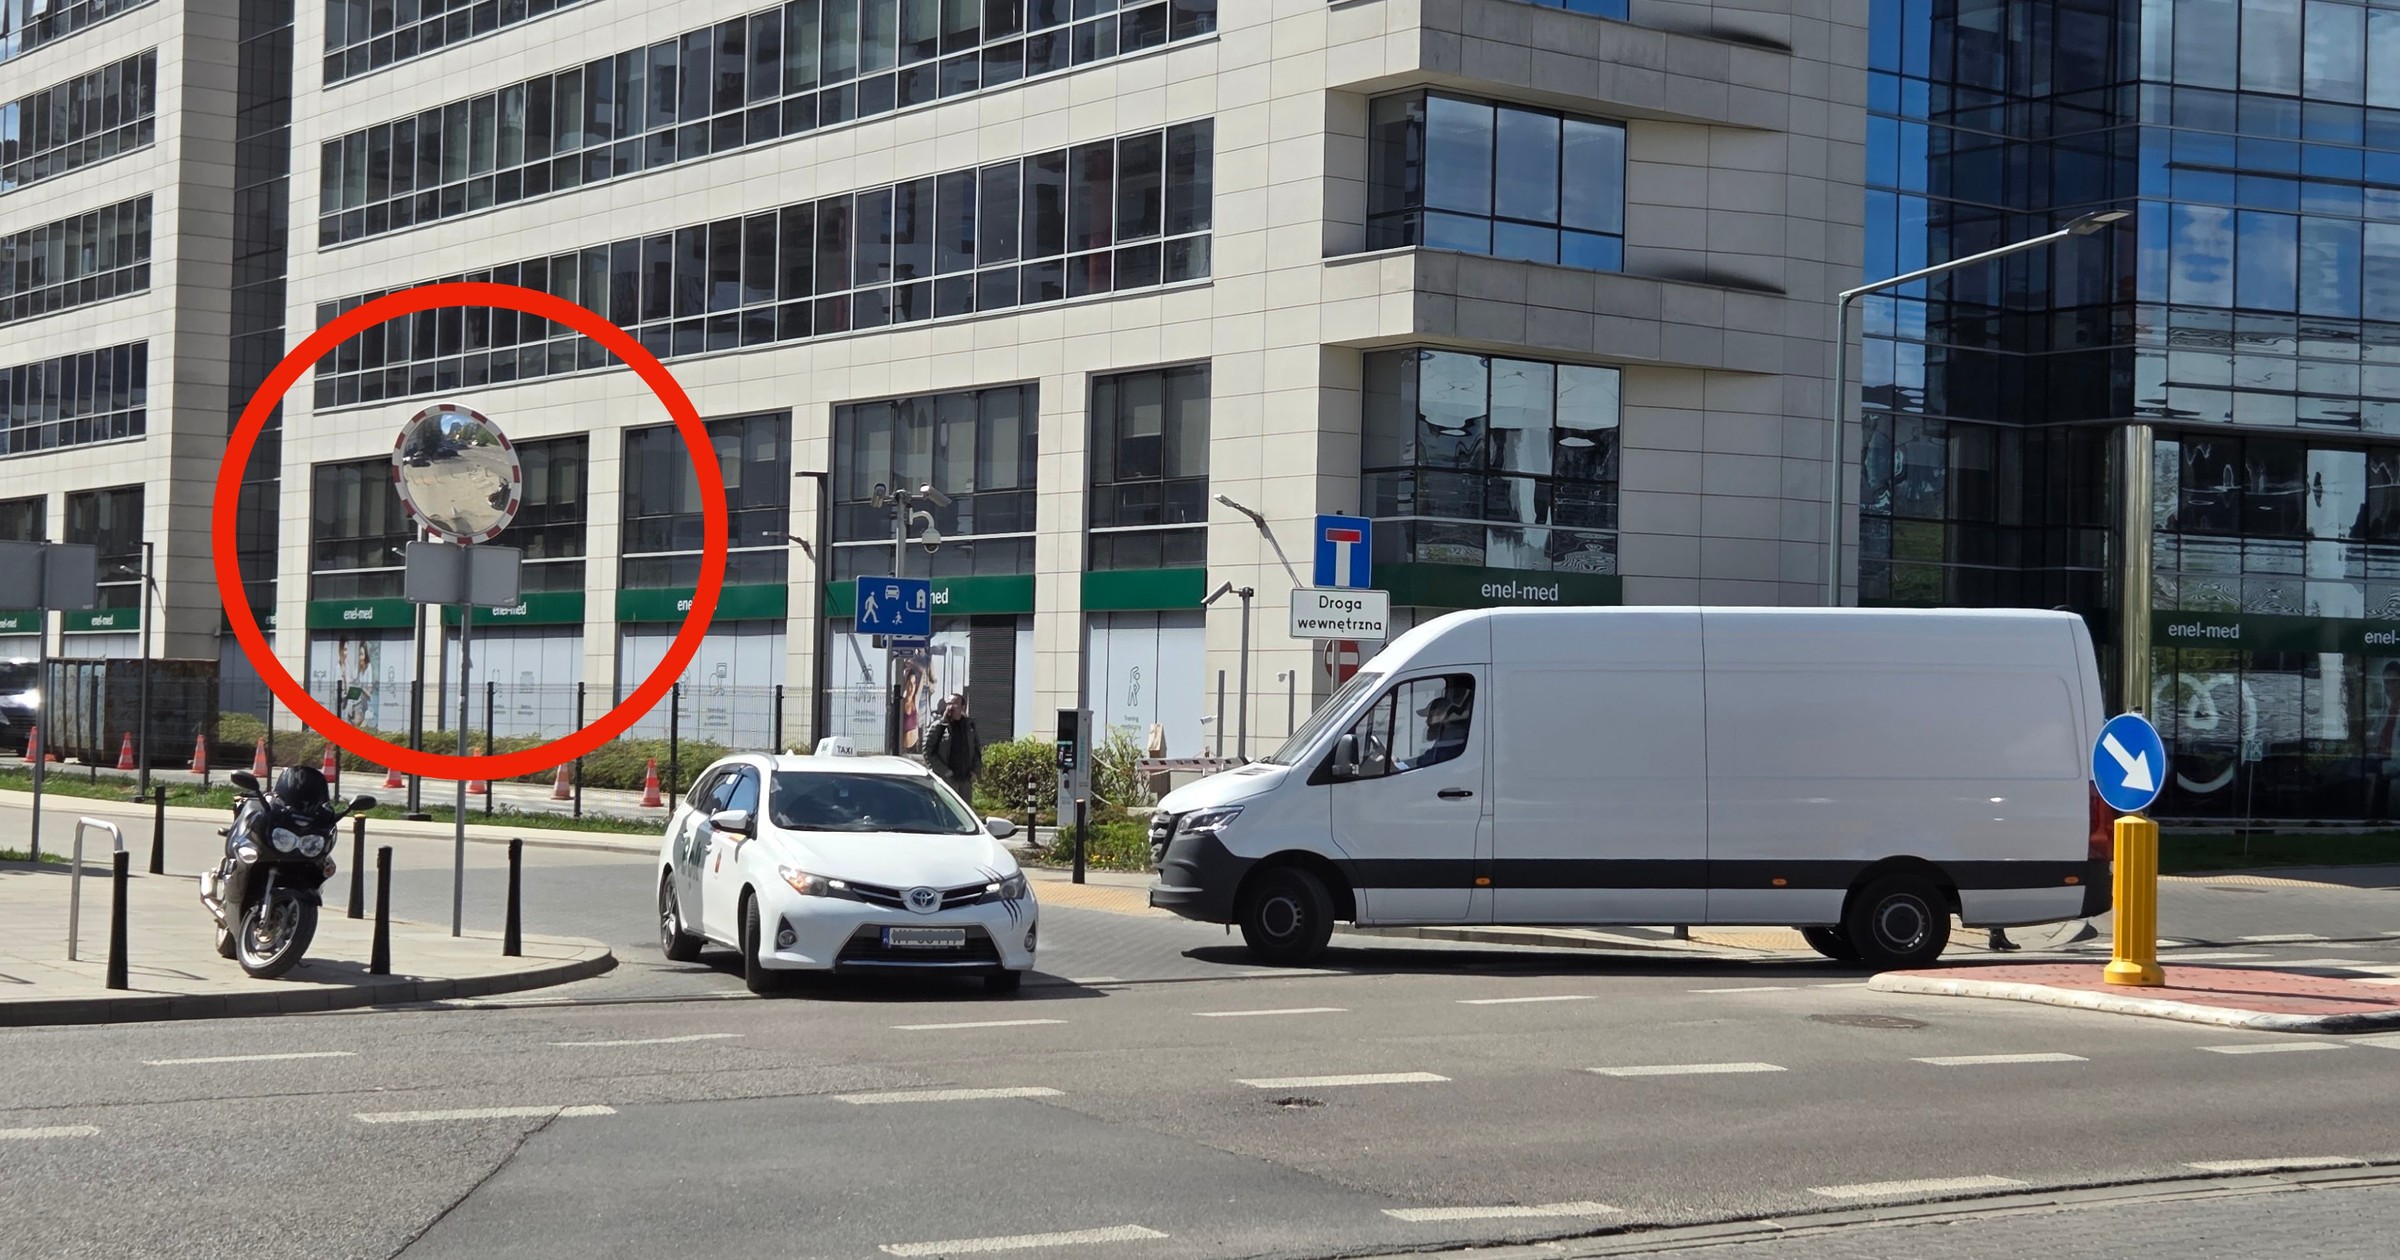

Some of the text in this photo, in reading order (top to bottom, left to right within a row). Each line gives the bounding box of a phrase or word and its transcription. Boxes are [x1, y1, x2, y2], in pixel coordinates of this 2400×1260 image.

[1481, 580, 1559, 602] enel-med
[1319, 595, 1362, 613] Droga
[343, 607, 374, 620] enel-med
[1297, 617, 1382, 633] wewnętrzna
[2168, 621, 2240, 639] enel-med
[837, 745, 853, 754] TAXI
